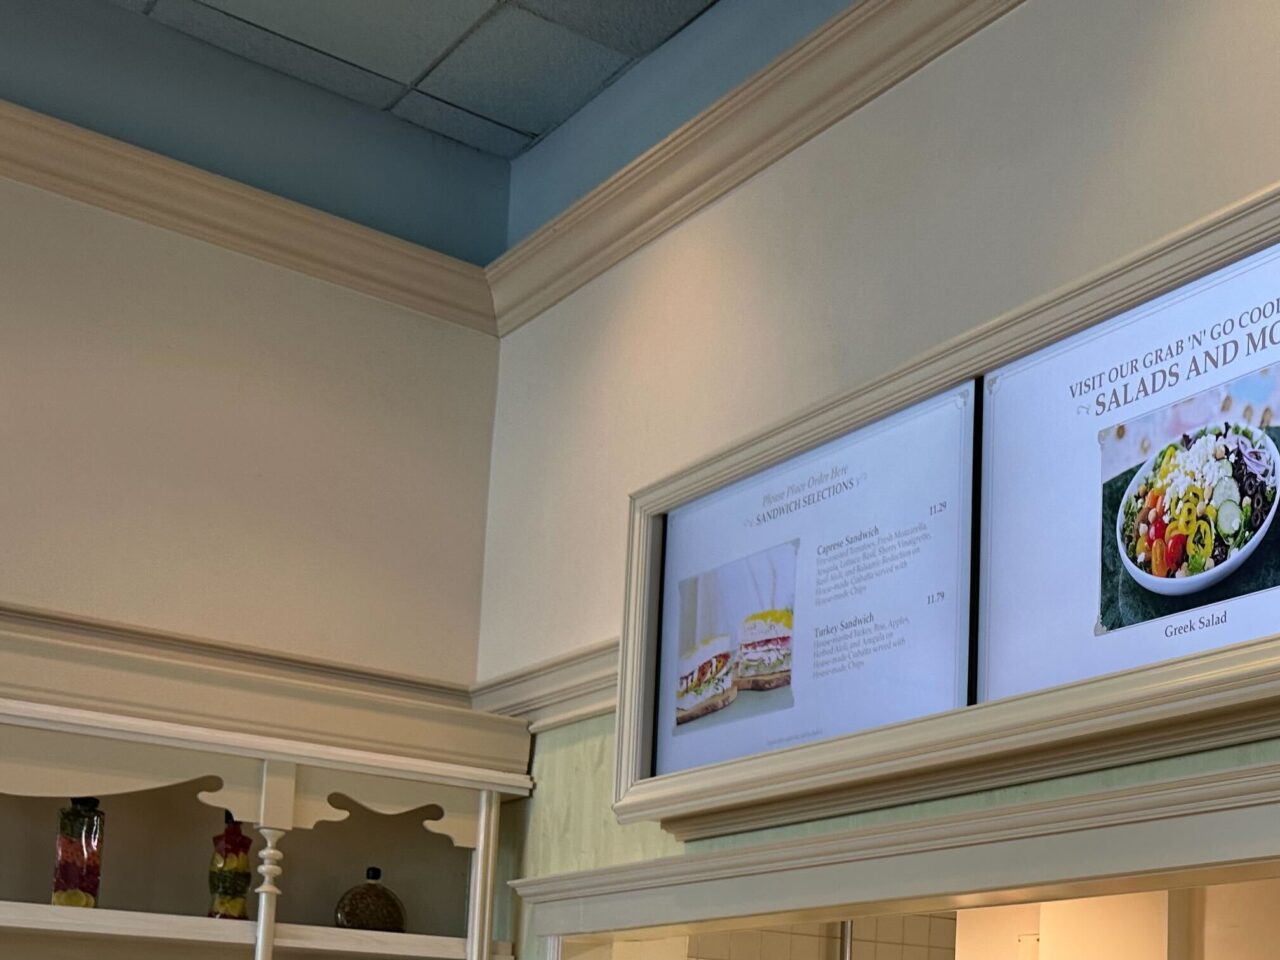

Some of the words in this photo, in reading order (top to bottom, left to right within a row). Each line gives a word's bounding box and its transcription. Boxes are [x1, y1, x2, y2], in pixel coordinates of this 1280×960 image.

[1069, 372, 1105, 399] VISIT
[1108, 360, 1138, 383] OUR
[1143, 341, 1184, 369] GRAB
[1188, 329, 1206, 350] 'N'
[1210, 319, 1235, 341] GO
[1095, 364, 1179, 416] SALADS
[1186, 340, 1239, 380] AND
[808, 473, 829, 489] Order
[831, 465, 848, 479] Here
[757, 500, 800, 525] SANDWICH
[802, 478, 854, 507] SELECTIONS
[929, 501, 947, 516] 11.29
[817, 540, 843, 556] Caprese
[845, 525, 879, 546] Sandwich
[927, 591, 944, 605] 11.79
[815, 625, 838, 638] Turkey
[840, 612, 874, 630] Sandwich
[1165, 620, 1195, 637] Greek
[1199, 611, 1226, 629] Salad
